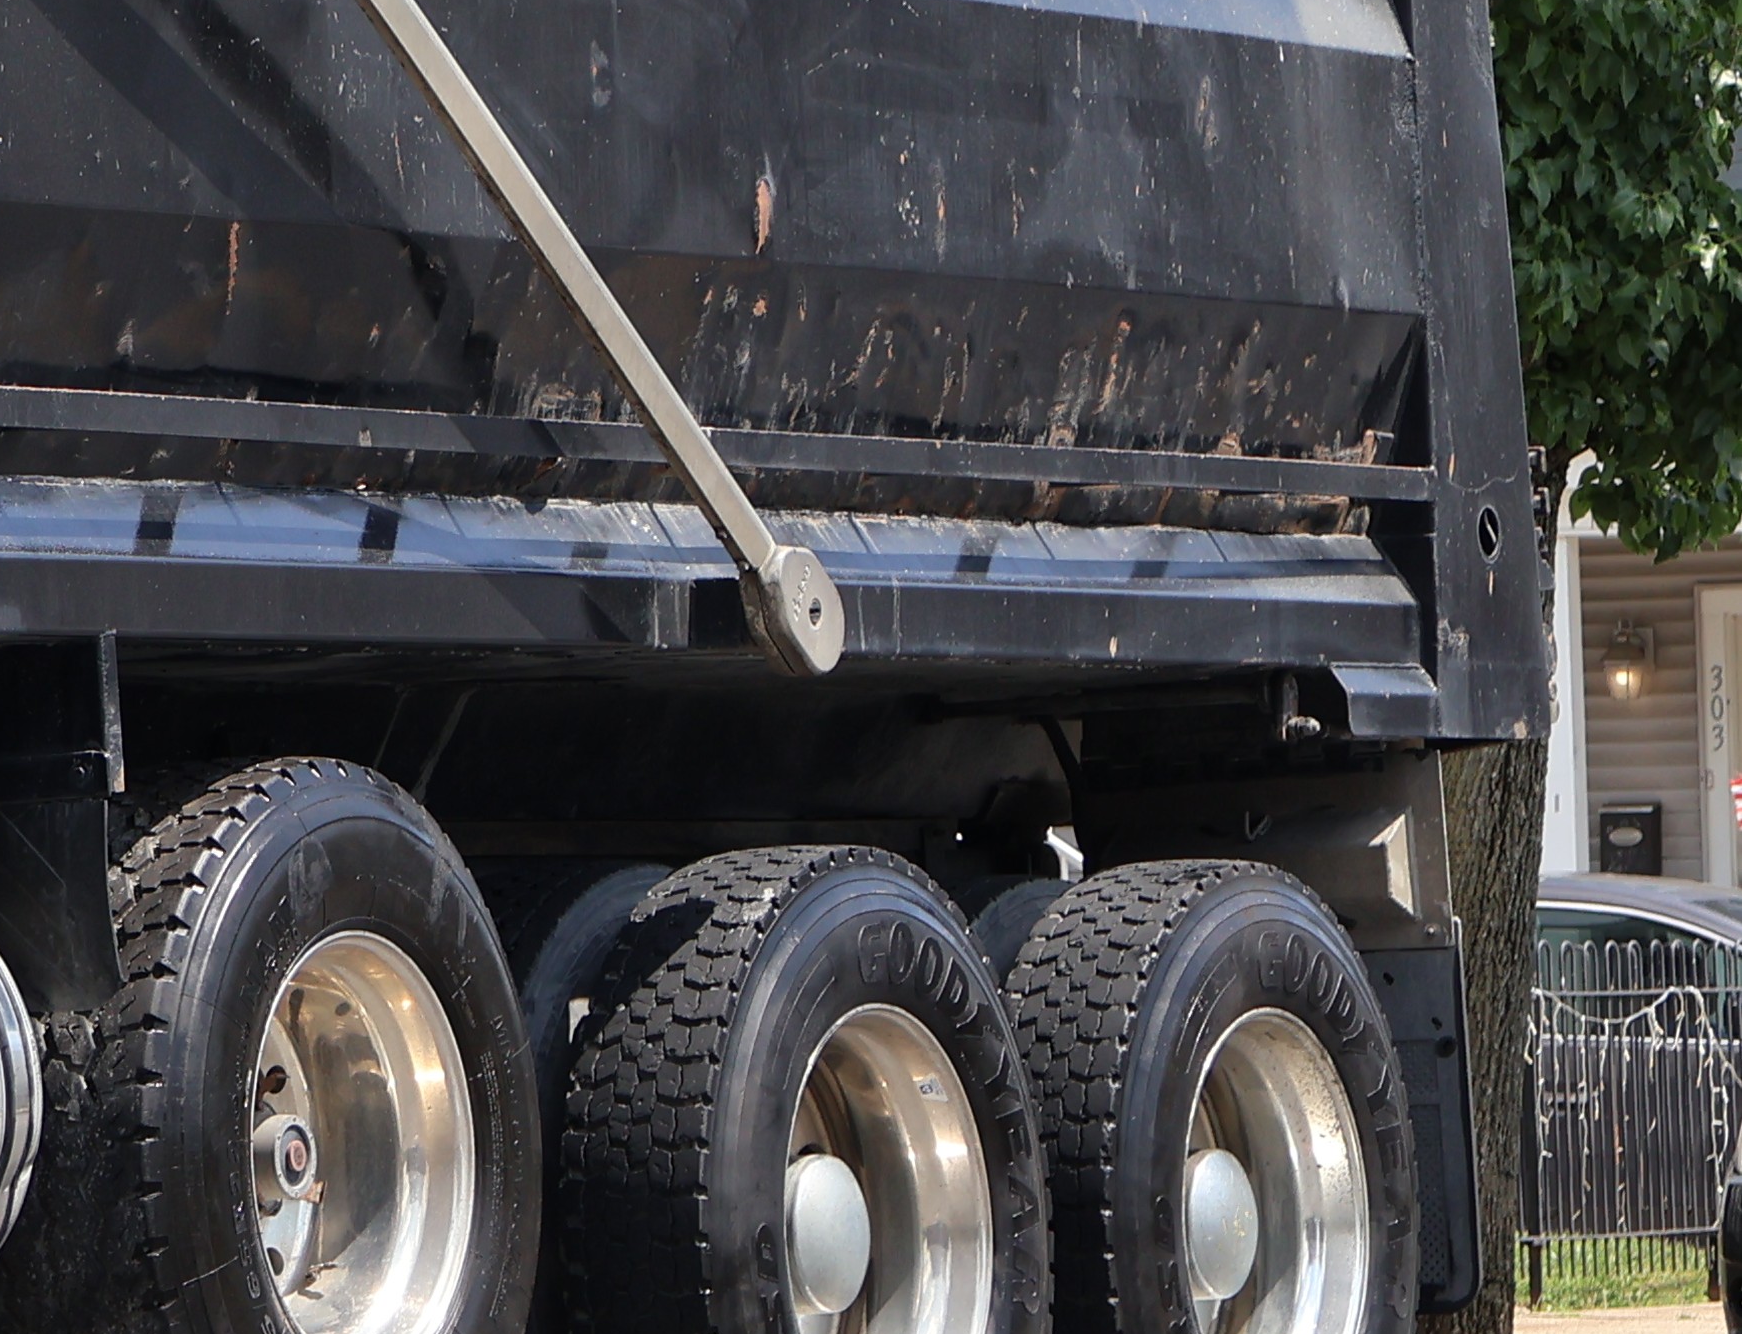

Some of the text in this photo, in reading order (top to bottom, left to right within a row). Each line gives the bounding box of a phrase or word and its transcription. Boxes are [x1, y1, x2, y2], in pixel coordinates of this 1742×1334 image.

[1710, 664, 1724, 752] 303
[857, 920, 1042, 1315] GOODYEAR
[1257, 928, 1413, 1319] GOODYEAR
